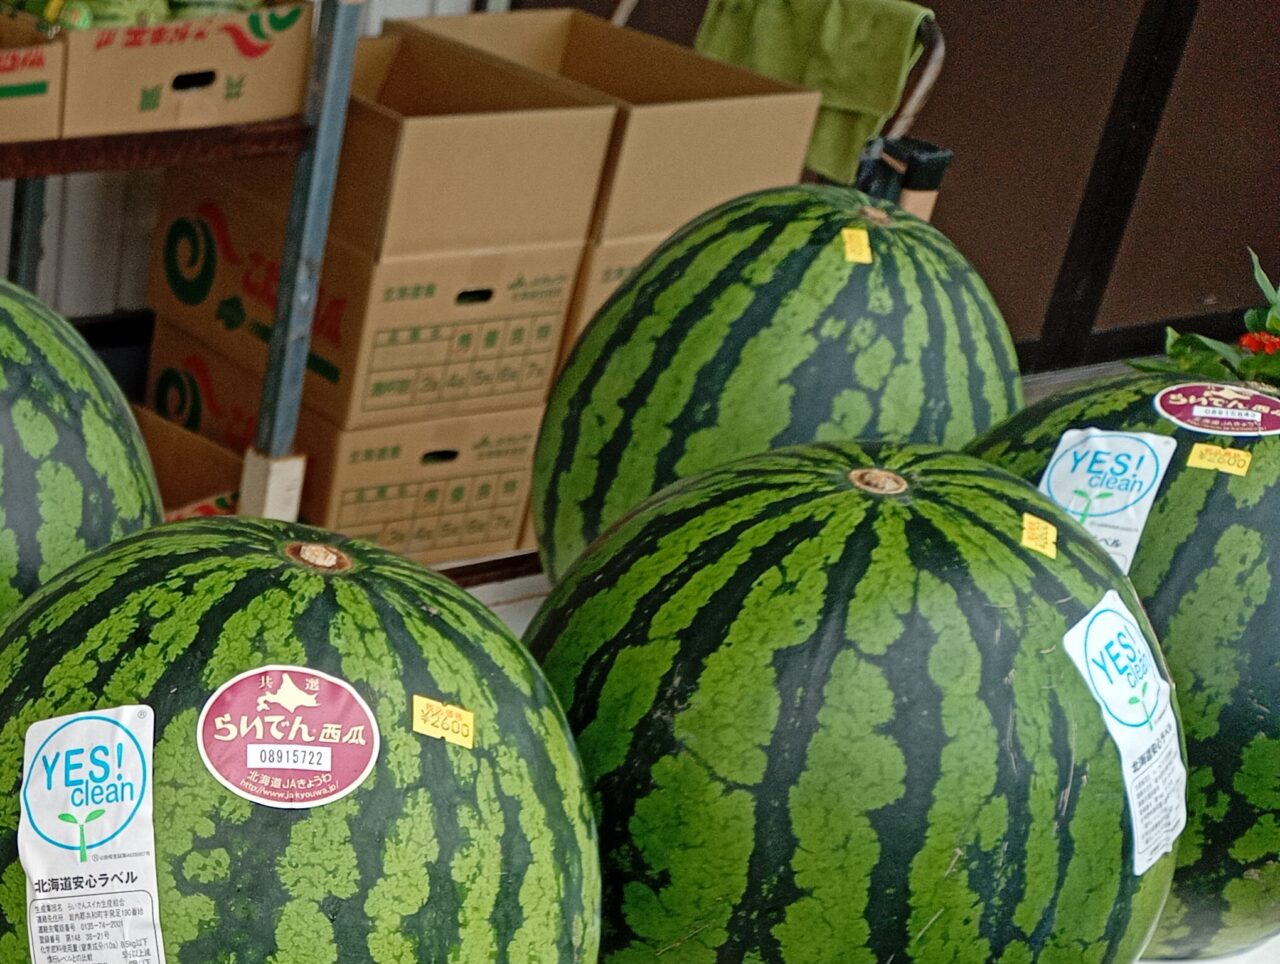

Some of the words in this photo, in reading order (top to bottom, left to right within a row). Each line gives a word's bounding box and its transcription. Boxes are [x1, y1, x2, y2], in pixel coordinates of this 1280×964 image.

[1070, 450, 1145, 475] YES!
[1089, 471, 1144, 493] clean
[41, 742, 124, 791] YES!
[259, 749, 324, 767] 08915722
[246, 770, 333, 790] 北海道JAきょうわ
[70, 778, 135, 808] clean
[34, 870, 139, 893] 北海道安心ラベル
